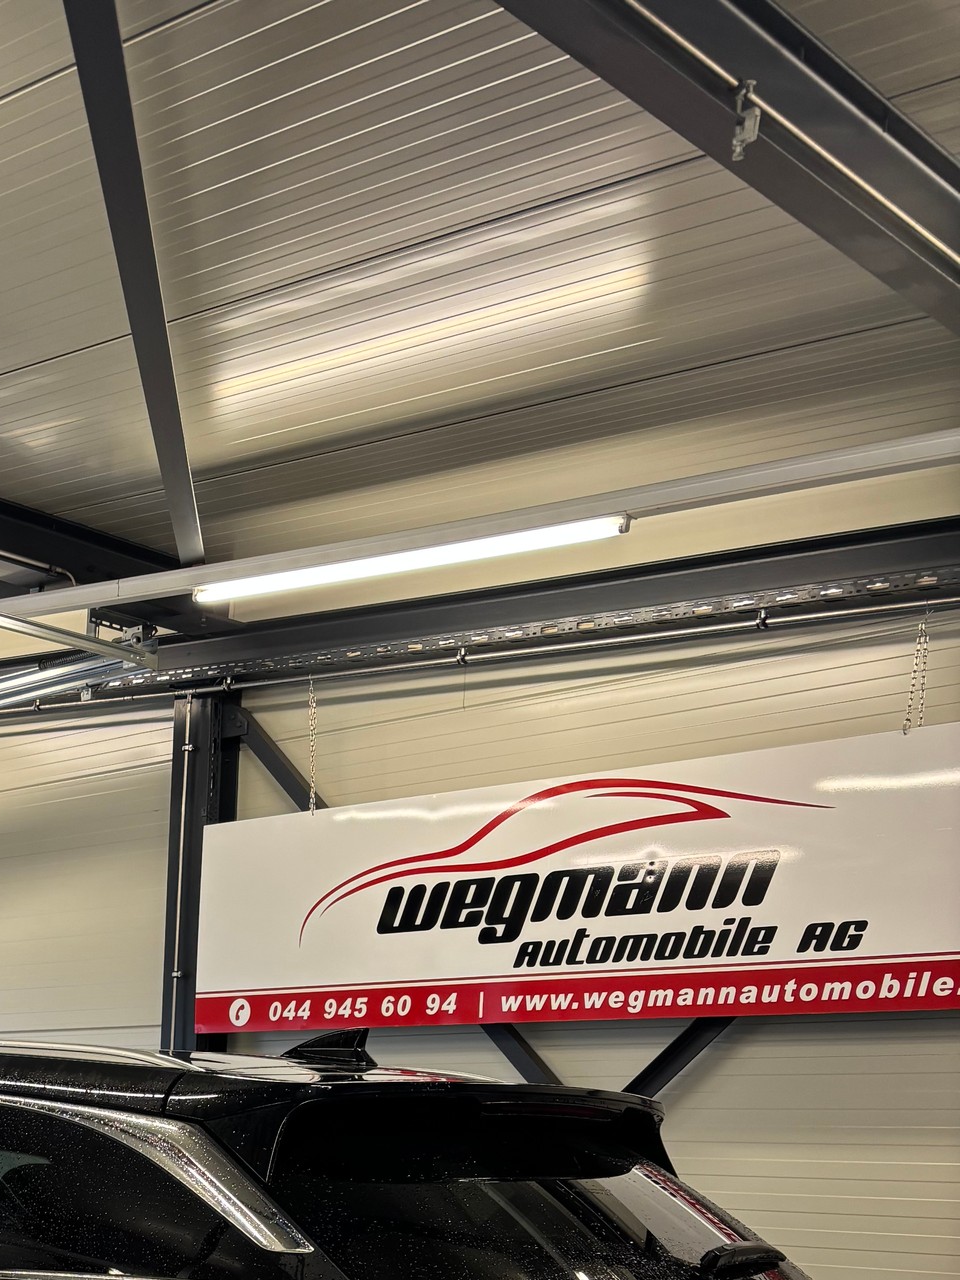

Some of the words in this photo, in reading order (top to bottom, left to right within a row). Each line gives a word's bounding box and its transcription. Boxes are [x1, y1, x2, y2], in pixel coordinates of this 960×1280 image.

[376, 849, 781, 944] wegmann
[513, 918, 778, 968] automobile
[796, 919, 869, 953] AG
[268, 1000, 311, 1021] 044
[323, 997, 368, 1019] 945
[380, 994, 412, 1017] 60
[425, 992, 458, 1015] 94
